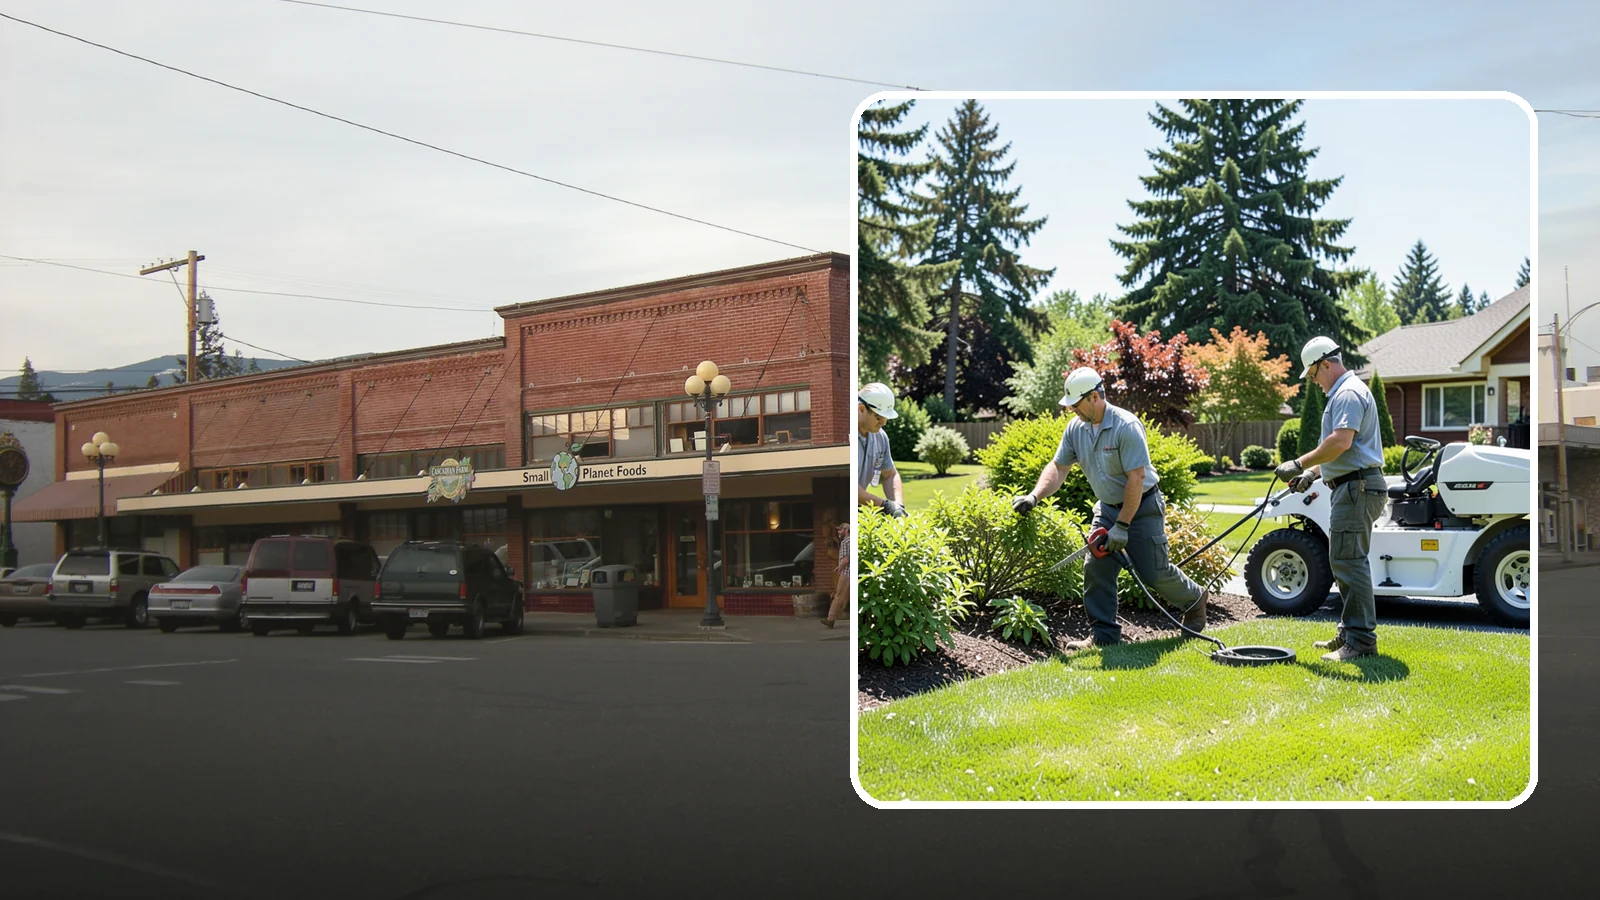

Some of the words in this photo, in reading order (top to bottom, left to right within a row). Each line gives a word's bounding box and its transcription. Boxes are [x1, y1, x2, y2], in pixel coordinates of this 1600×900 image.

[523, 471, 549, 483] Small
[583, 467, 614, 479] Planet
[616, 465, 647, 477] Foods
